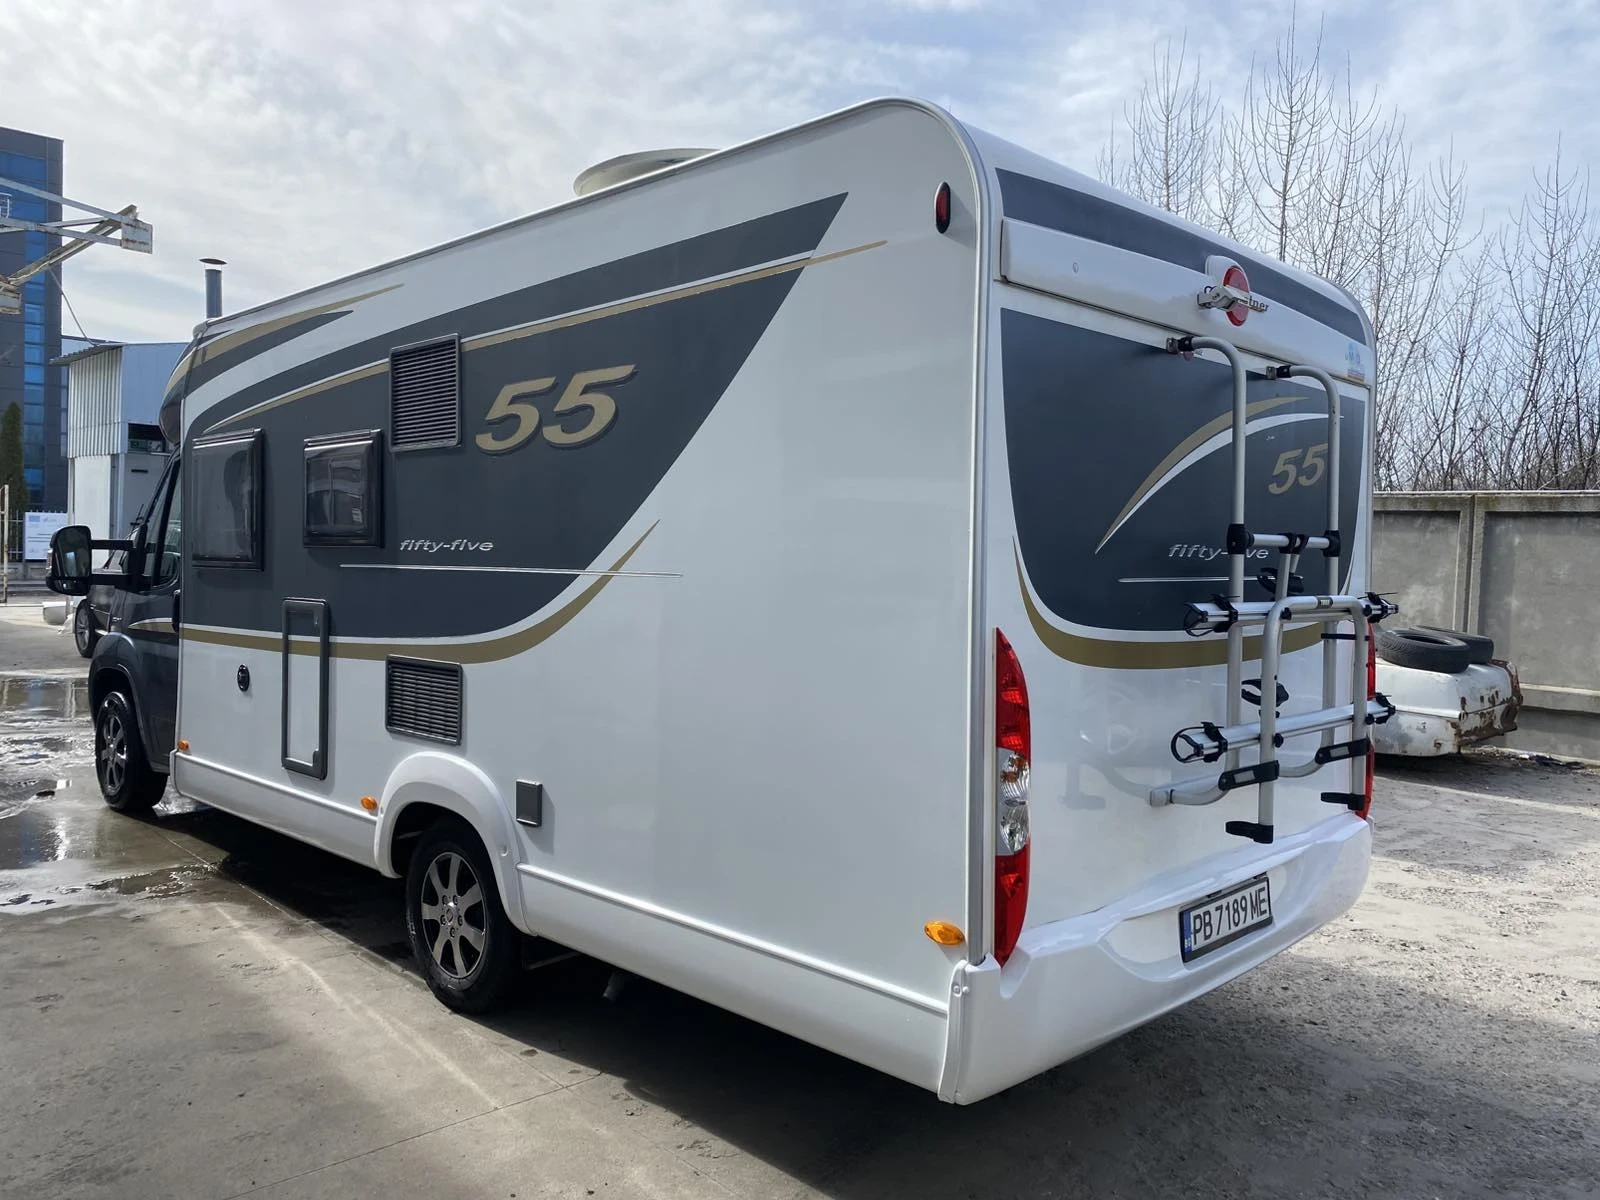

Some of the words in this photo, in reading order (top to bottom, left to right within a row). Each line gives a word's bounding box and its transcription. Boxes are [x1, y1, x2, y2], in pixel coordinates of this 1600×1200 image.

[475, 364, 638, 455] 55
[1268, 442, 1329, 496] 55
[399, 538, 494, 553] fifty-five
[1168, 544, 1270, 561] fifty-ve
